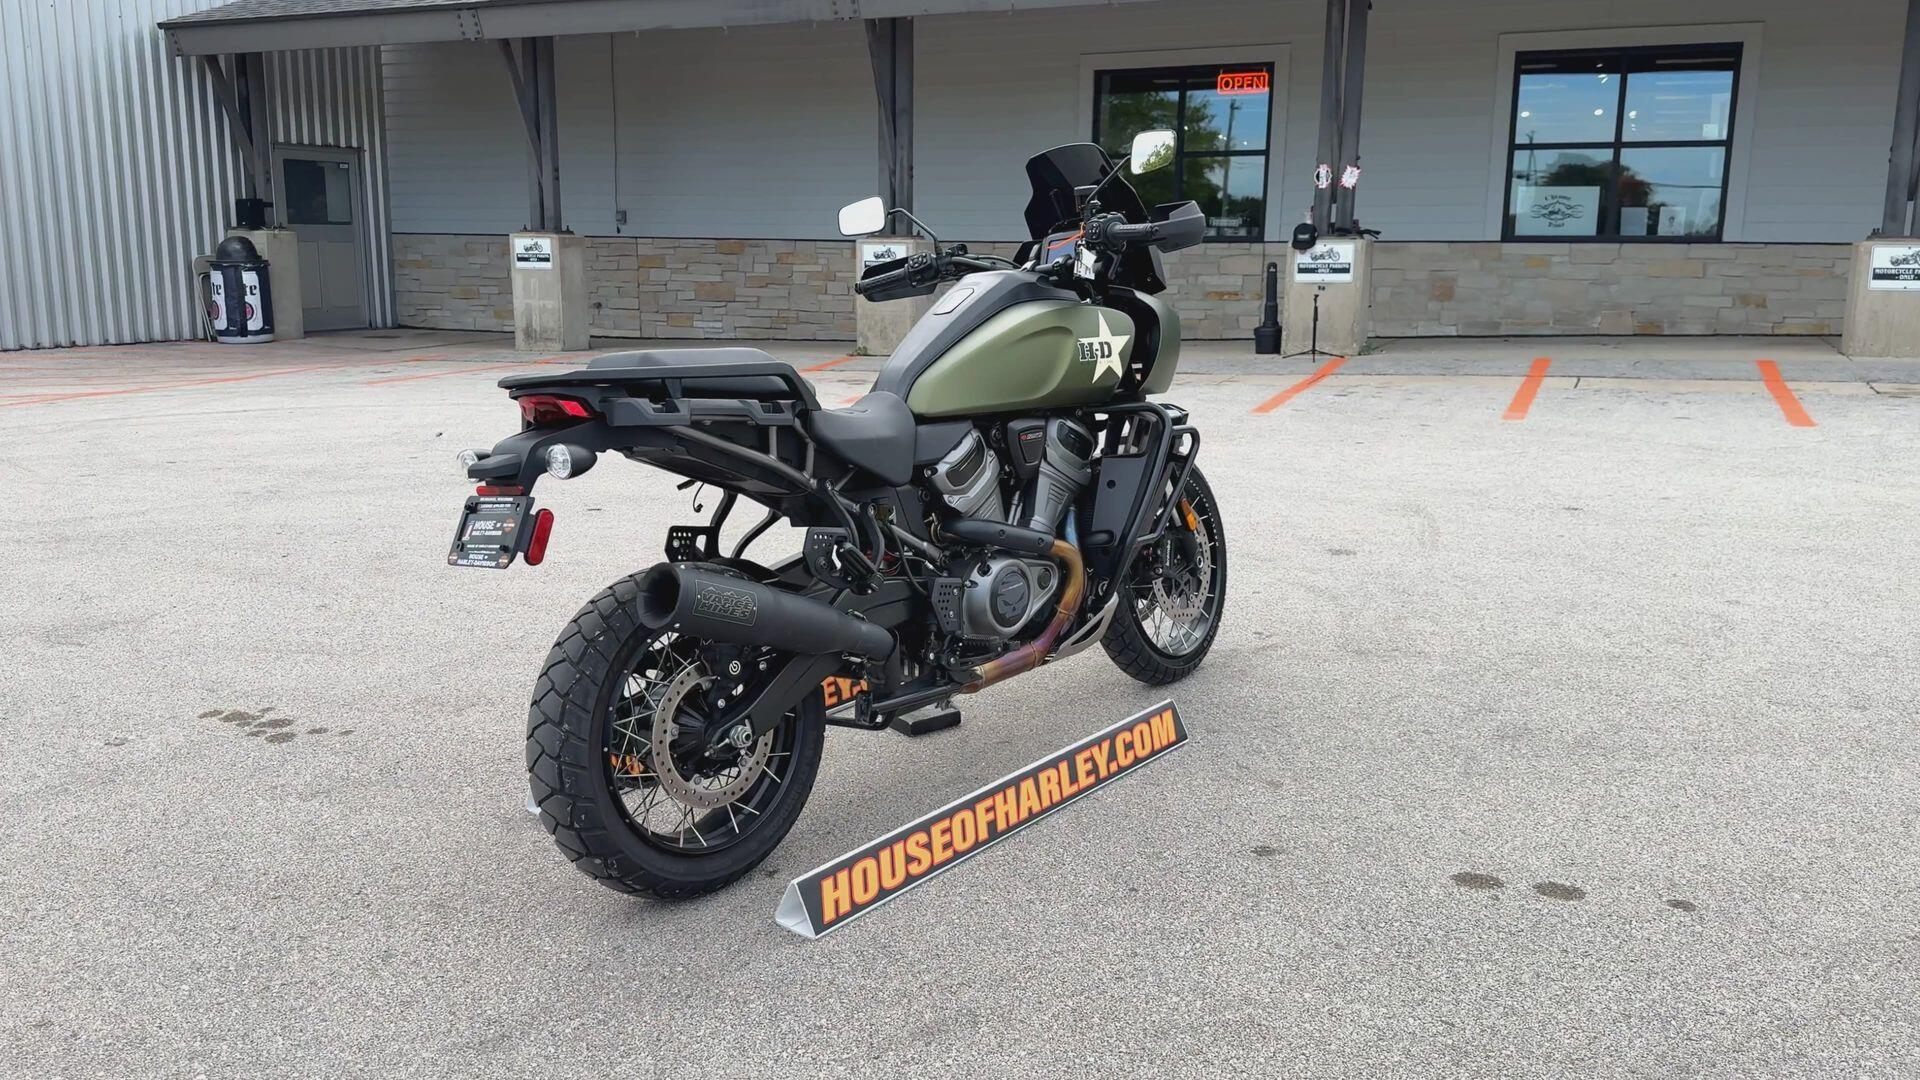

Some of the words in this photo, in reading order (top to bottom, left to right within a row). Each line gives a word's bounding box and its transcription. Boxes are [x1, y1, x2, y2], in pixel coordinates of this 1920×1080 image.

[1222, 76, 1264, 91] OPEN
[211, 282, 222, 296] te
[1078, 341, 1113, 361] H-D
[473, 521, 497, 529] HOUSE
[820, 708, 1178, 925] HOUSEOFHARLEY.COM
